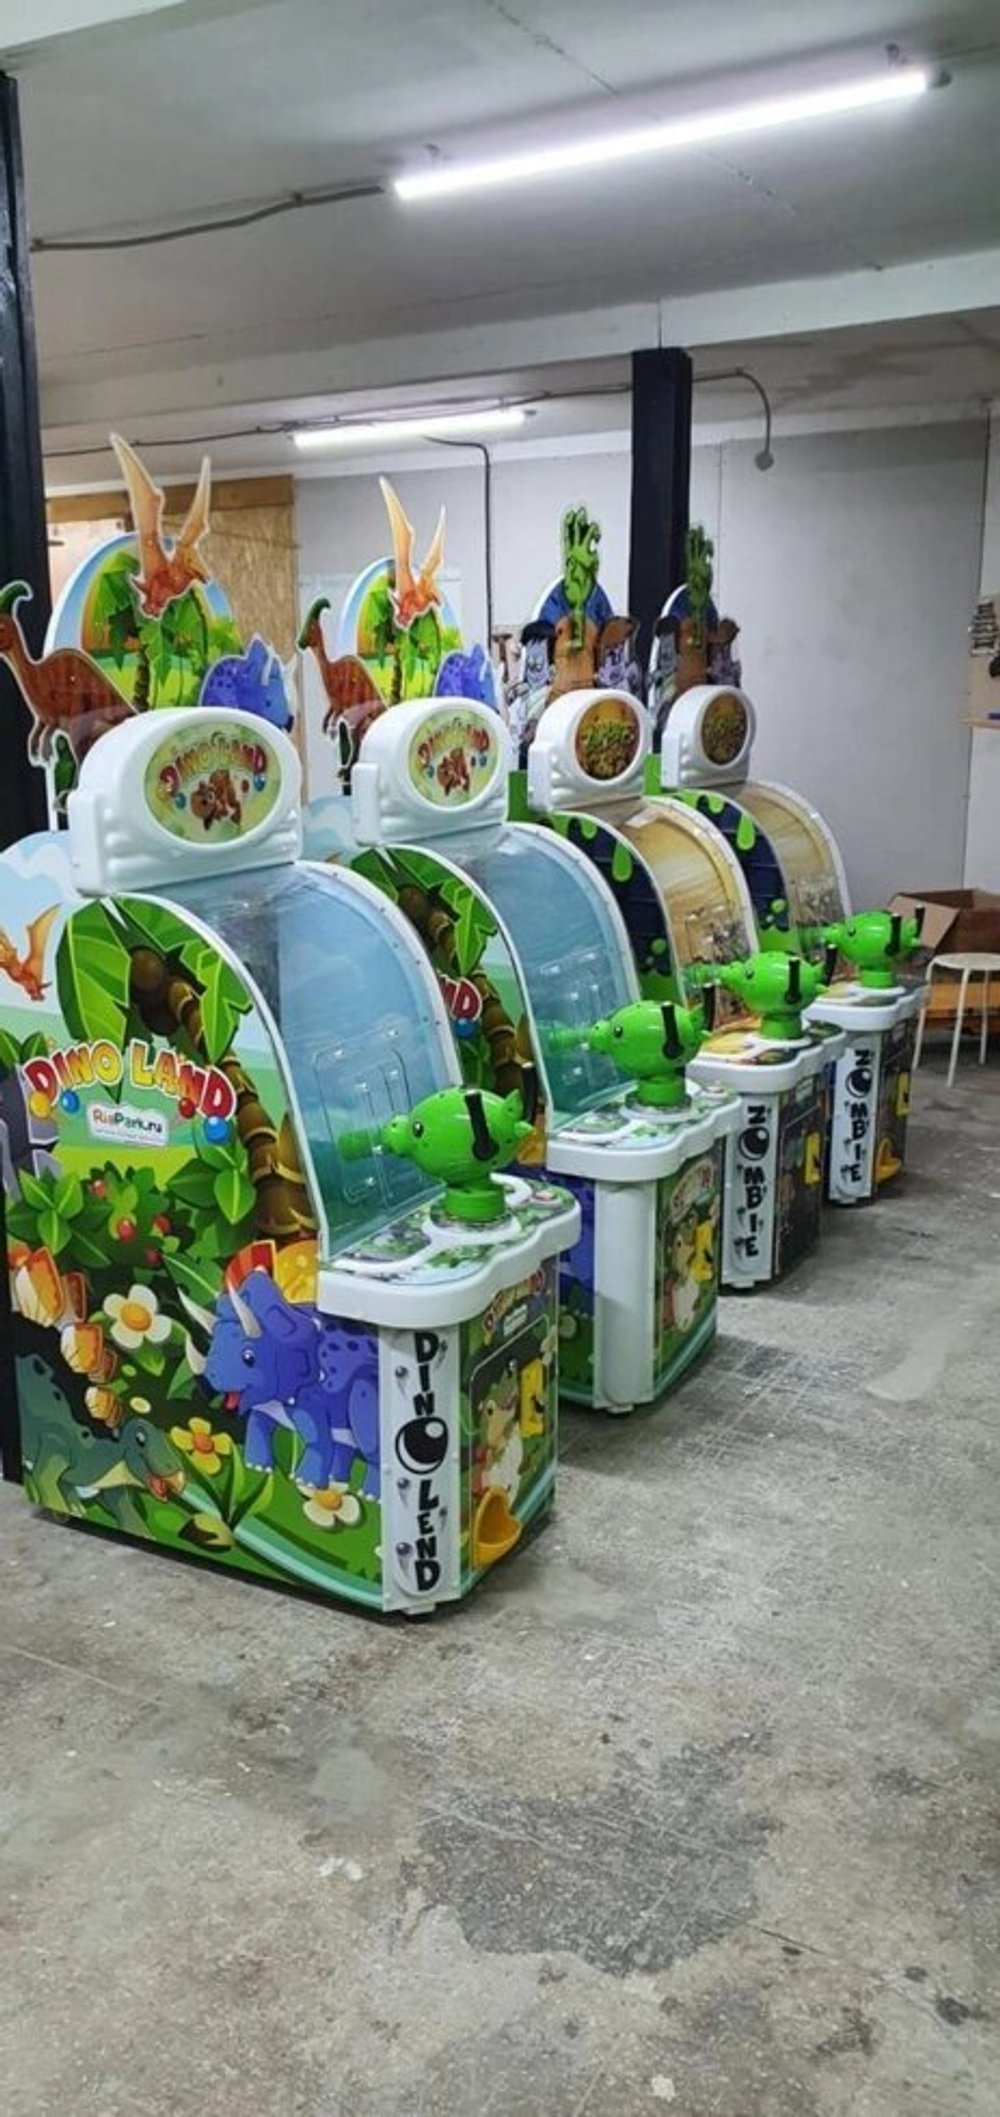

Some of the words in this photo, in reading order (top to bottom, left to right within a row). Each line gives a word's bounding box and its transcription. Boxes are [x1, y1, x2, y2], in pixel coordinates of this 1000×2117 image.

[23, 1039, 123, 1106] DINO
[129, 1038, 237, 1120] LAND
[846, 1050, 873, 1182] ZOMBIE
[738, 1106, 770, 1257] ZOMBIE
